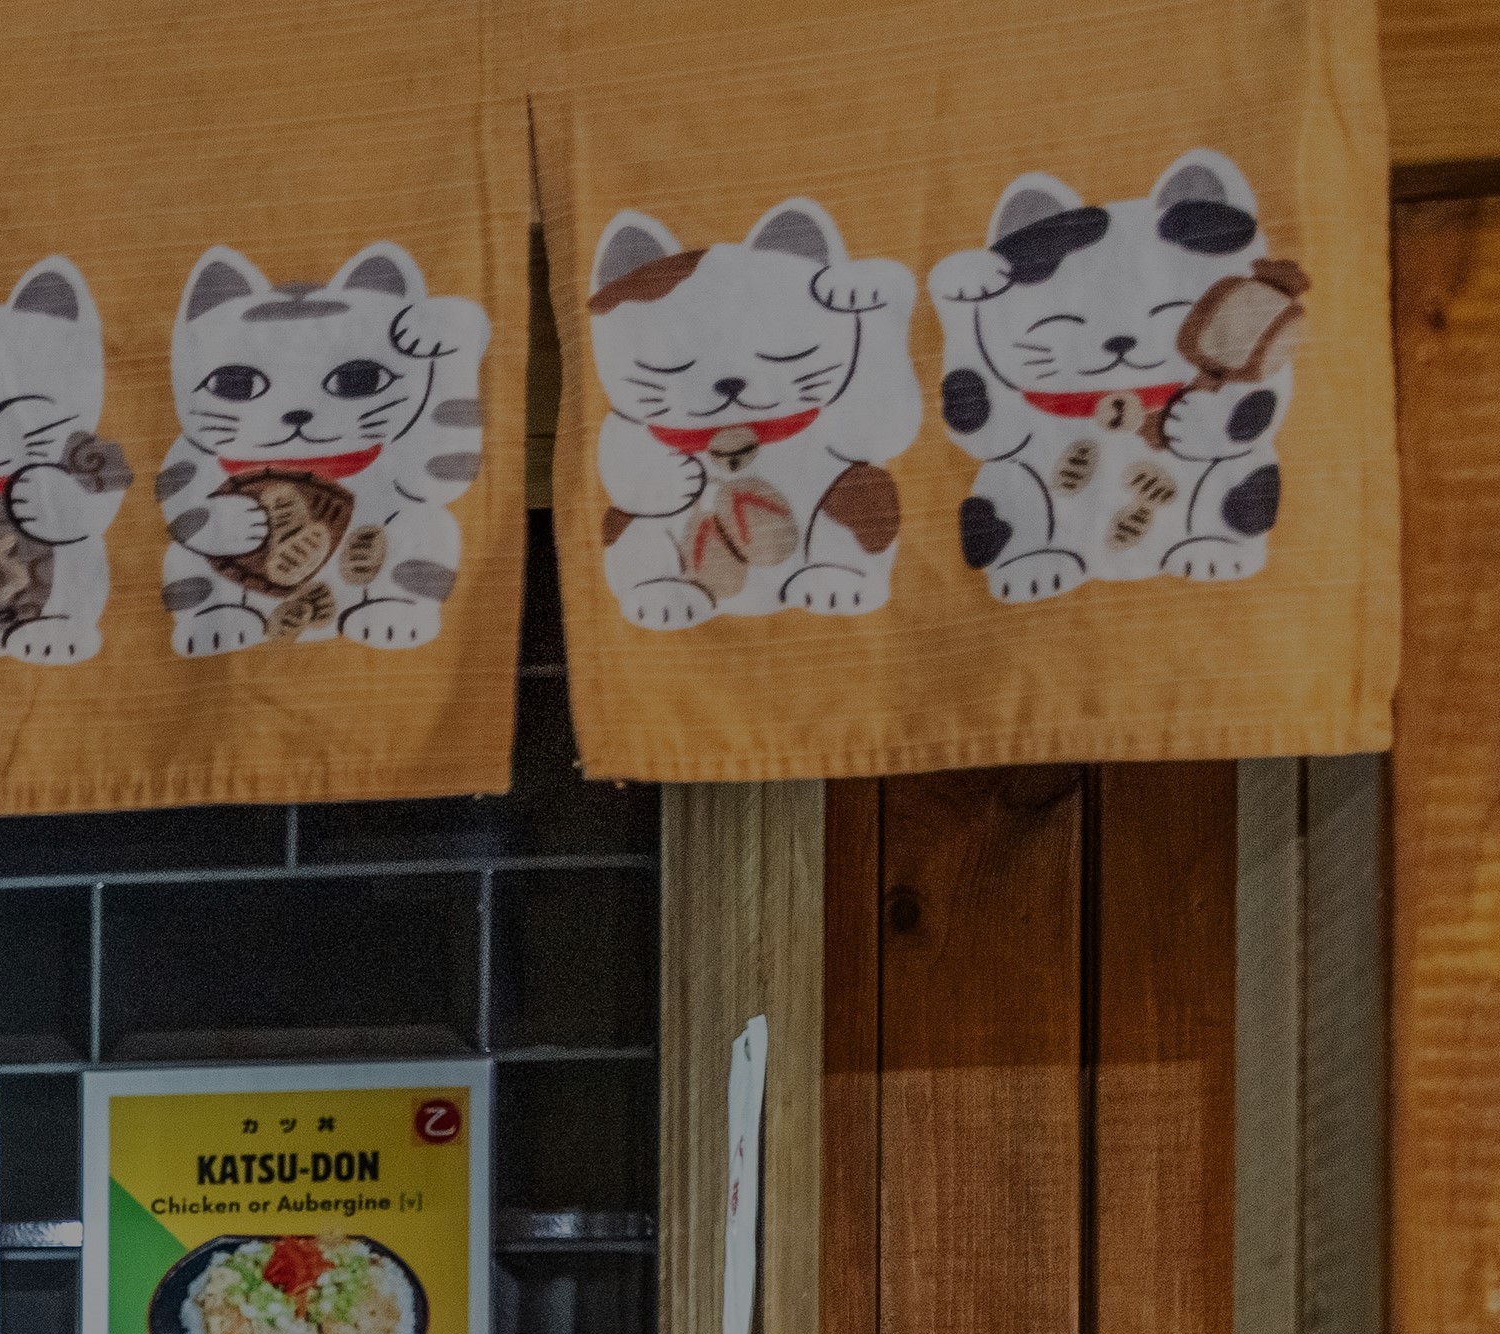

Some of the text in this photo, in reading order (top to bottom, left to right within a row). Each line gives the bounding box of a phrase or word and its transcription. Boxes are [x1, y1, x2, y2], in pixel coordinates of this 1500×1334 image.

[242, 1115, 335, 1135] カツ丼
[197, 1151, 380, 1185] KATSU-DON
[151, 1196, 240, 1216] Chicken
[249, 1198, 270, 1213] or
[277, 1195, 390, 1217] Aubergine
